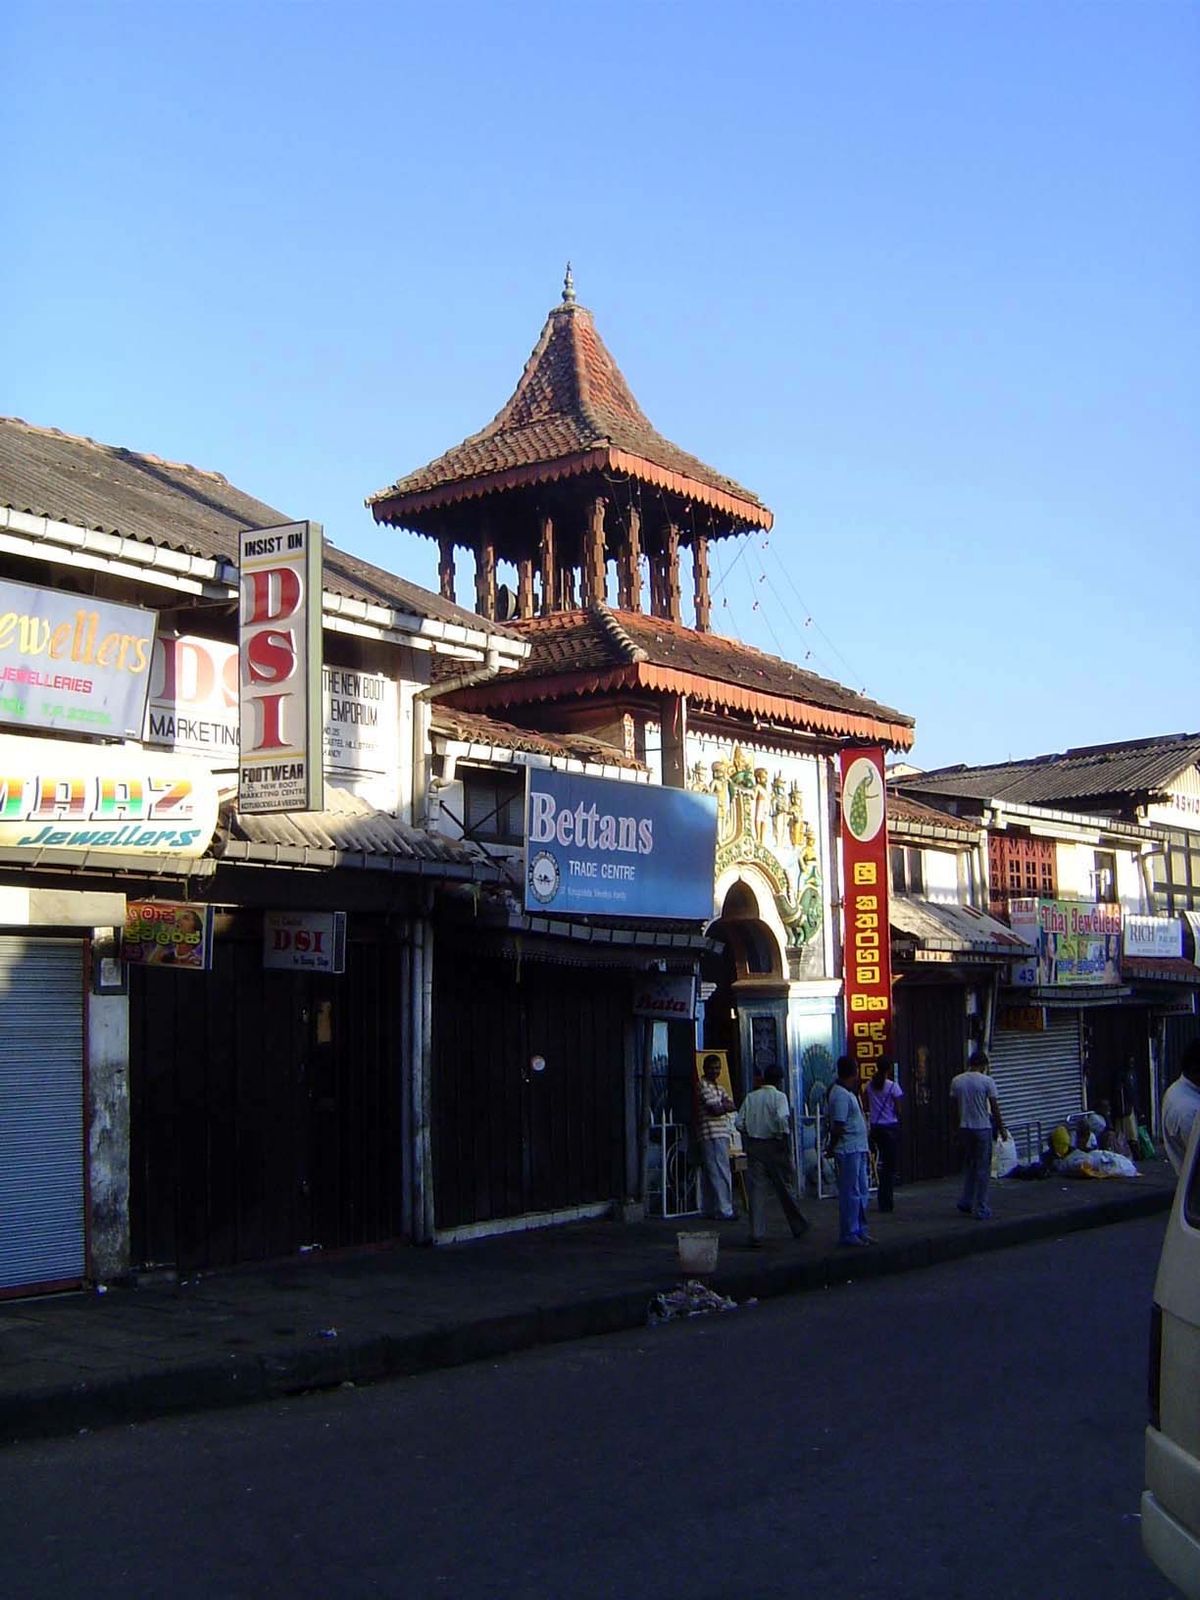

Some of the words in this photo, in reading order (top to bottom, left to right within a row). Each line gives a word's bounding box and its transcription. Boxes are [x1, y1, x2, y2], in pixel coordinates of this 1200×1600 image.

[245, 537, 283, 557] INSIST
[287, 533, 303, 551] ON
[242, 567, 303, 751] DSI
[0, 666, 94, 694] JEWELLERIES
[322, 670, 340, 694] THE
[341, 672, 360, 697] NEW
[363, 677, 385, 701] BOOT
[331, 699, 378, 726] EMPORIUM
[242, 764, 304, 783] FOOTWEAR
[278, 781, 298, 790] BOOT
[240, 790, 279, 799] MARKETING
[530, 792, 653, 855] Bettans
[17, 825, 201, 847] Jewellers
[569, 860, 597, 878] TRADE
[601, 864, 635, 881] CENTRE
[1071, 906, 1122, 935] Jewellers
[272, 928, 325, 953] DSI
[1130, 924, 1155, 943] RICH
